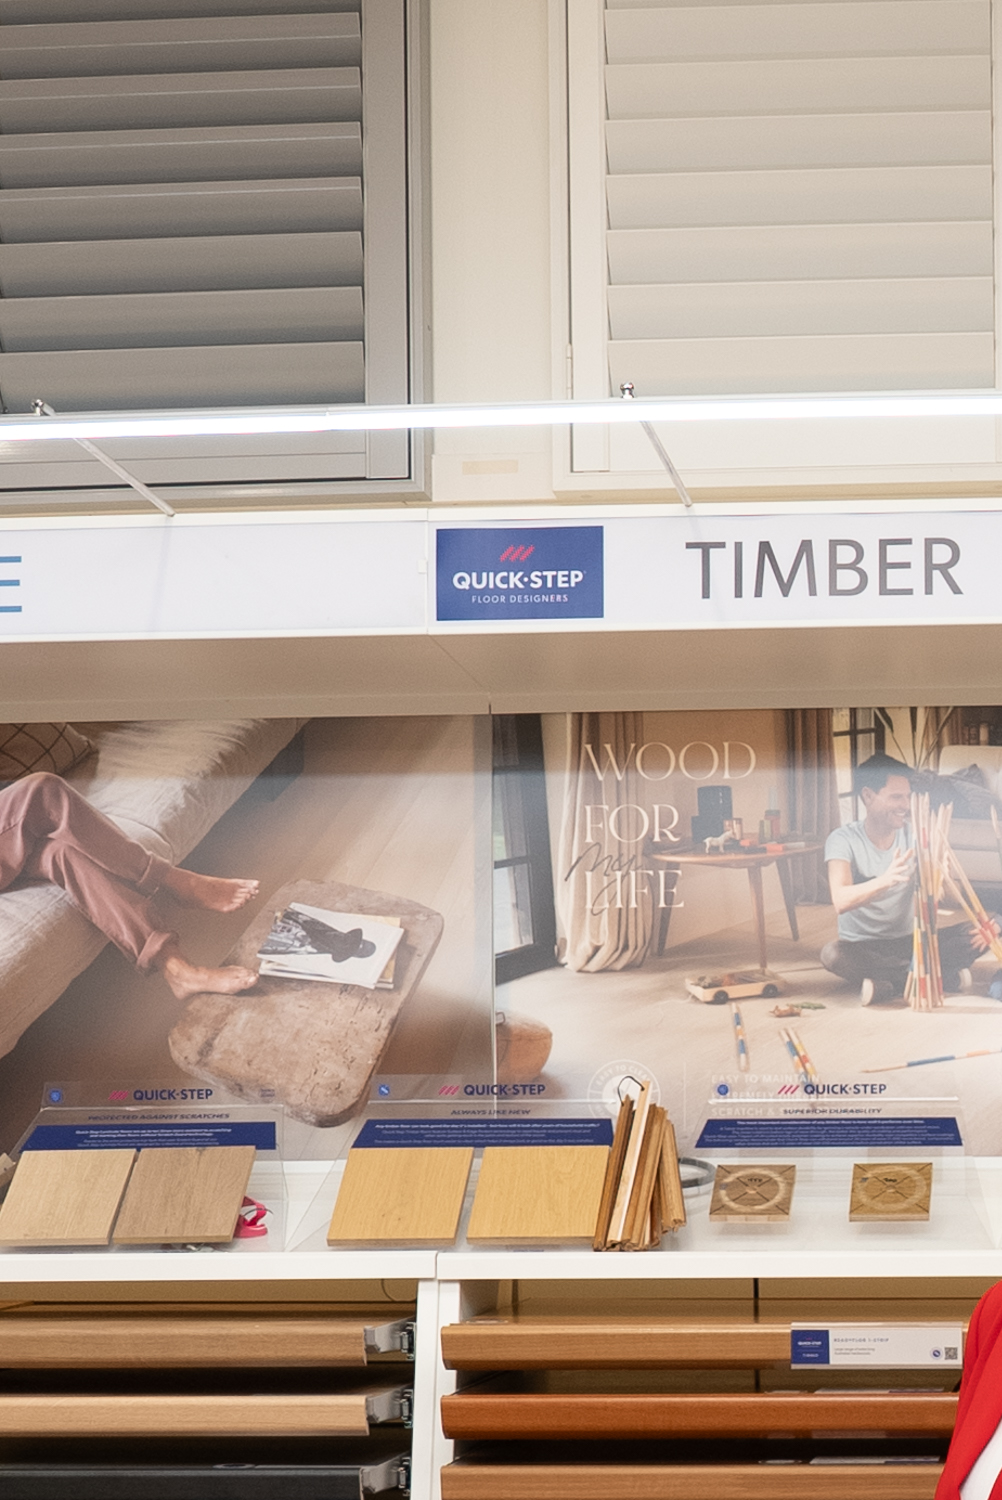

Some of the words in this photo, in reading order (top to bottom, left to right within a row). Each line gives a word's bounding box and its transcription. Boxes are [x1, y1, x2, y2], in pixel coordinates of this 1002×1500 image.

[685, 536, 964, 600] TIMBER
[471, 594, 506, 605] FLOOR
[509, 593, 569, 604] DESIGNERS
[584, 741, 757, 781] WOOD
[584, 803, 683, 843] FOR
[584, 868, 685, 909] LIFE
